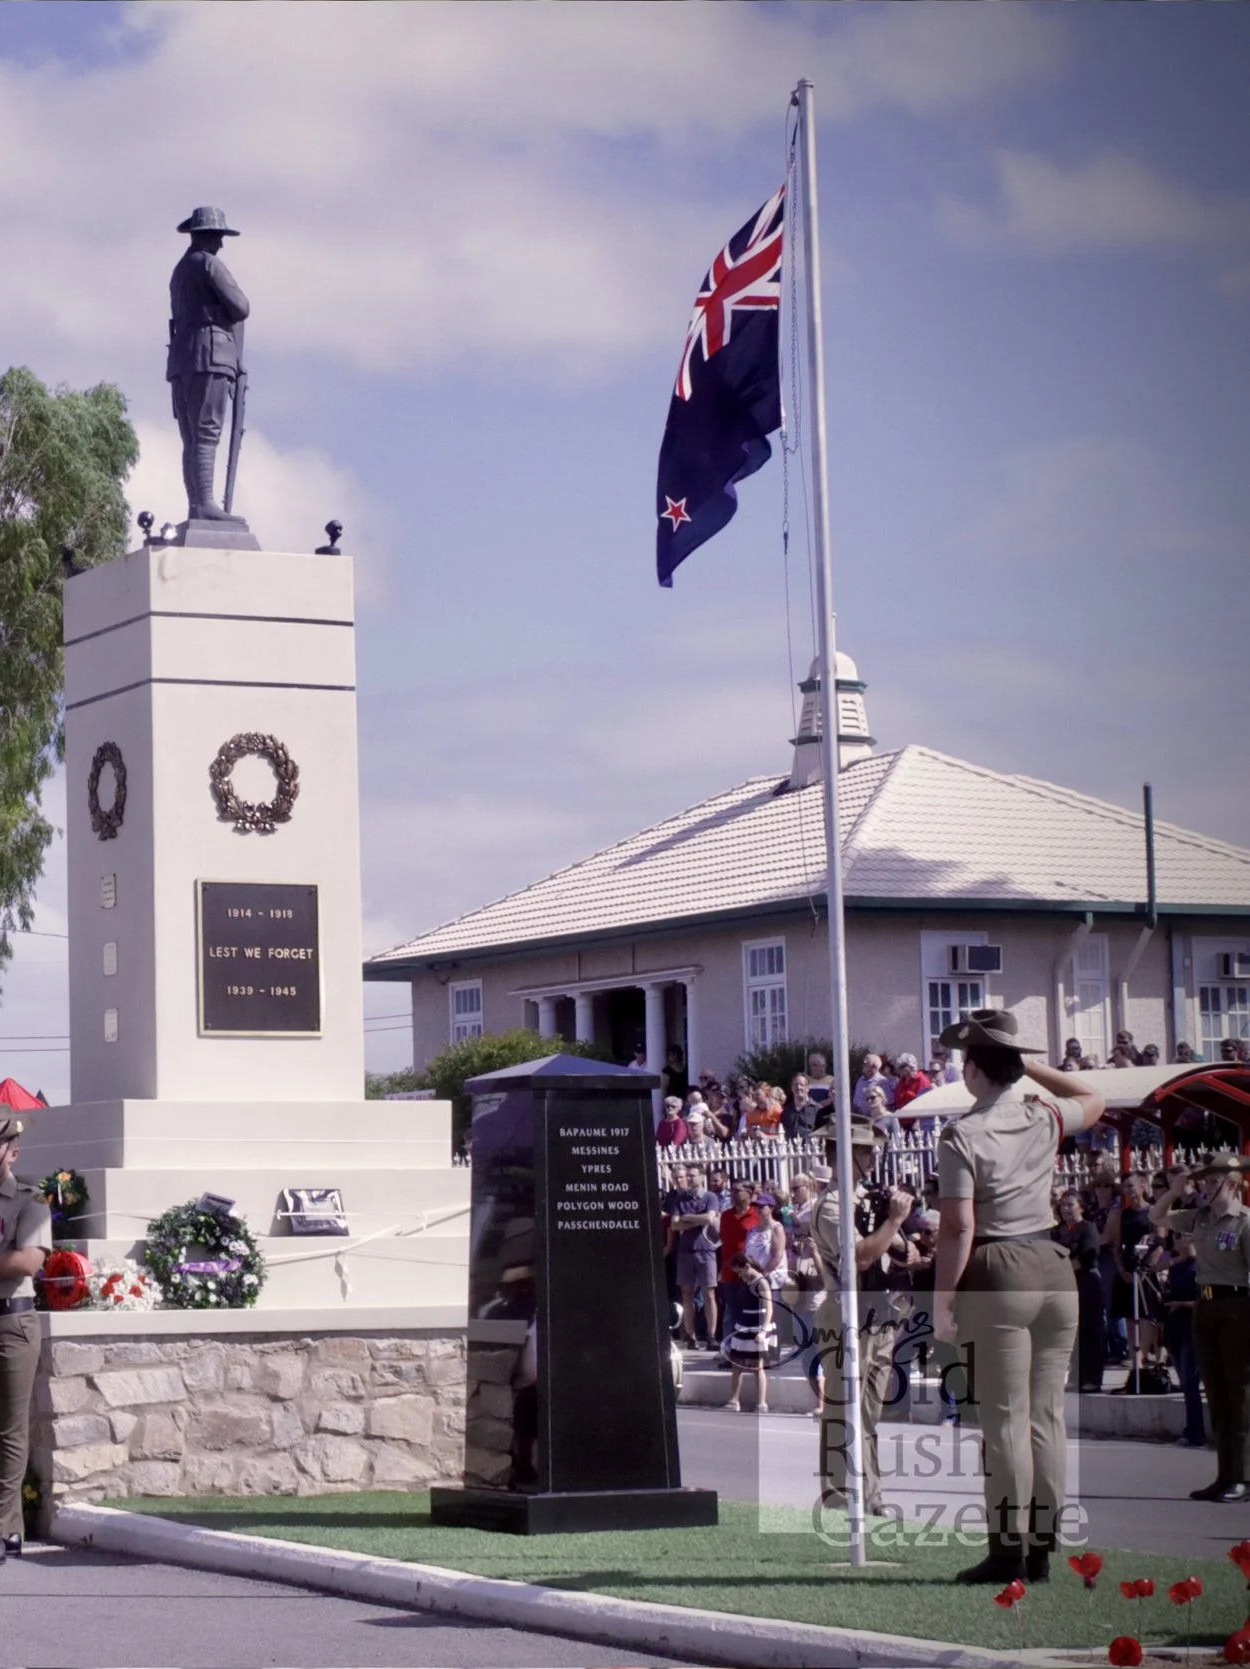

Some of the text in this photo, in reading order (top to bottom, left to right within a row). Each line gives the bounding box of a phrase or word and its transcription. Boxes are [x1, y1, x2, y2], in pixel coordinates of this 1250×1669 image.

[227, 907, 252, 919] 1914
[270, 908, 293, 919] 1918
[209, 946, 313, 960] LEST WE FORGET
[227, 985, 253, 996] 1939
[270, 985, 296, 996] 1945
[559, 1127, 630, 1137] BAPAUME 1917
[571, 1146, 620, 1155] MESSINES
[581, 1164, 612, 1174] YPRES
[565, 1182, 629, 1192] MENIN ROAD
[557, 1200, 639, 1211] POLYGON WOOD
[557, 1220, 640, 1230] PASSCHENDAELE
